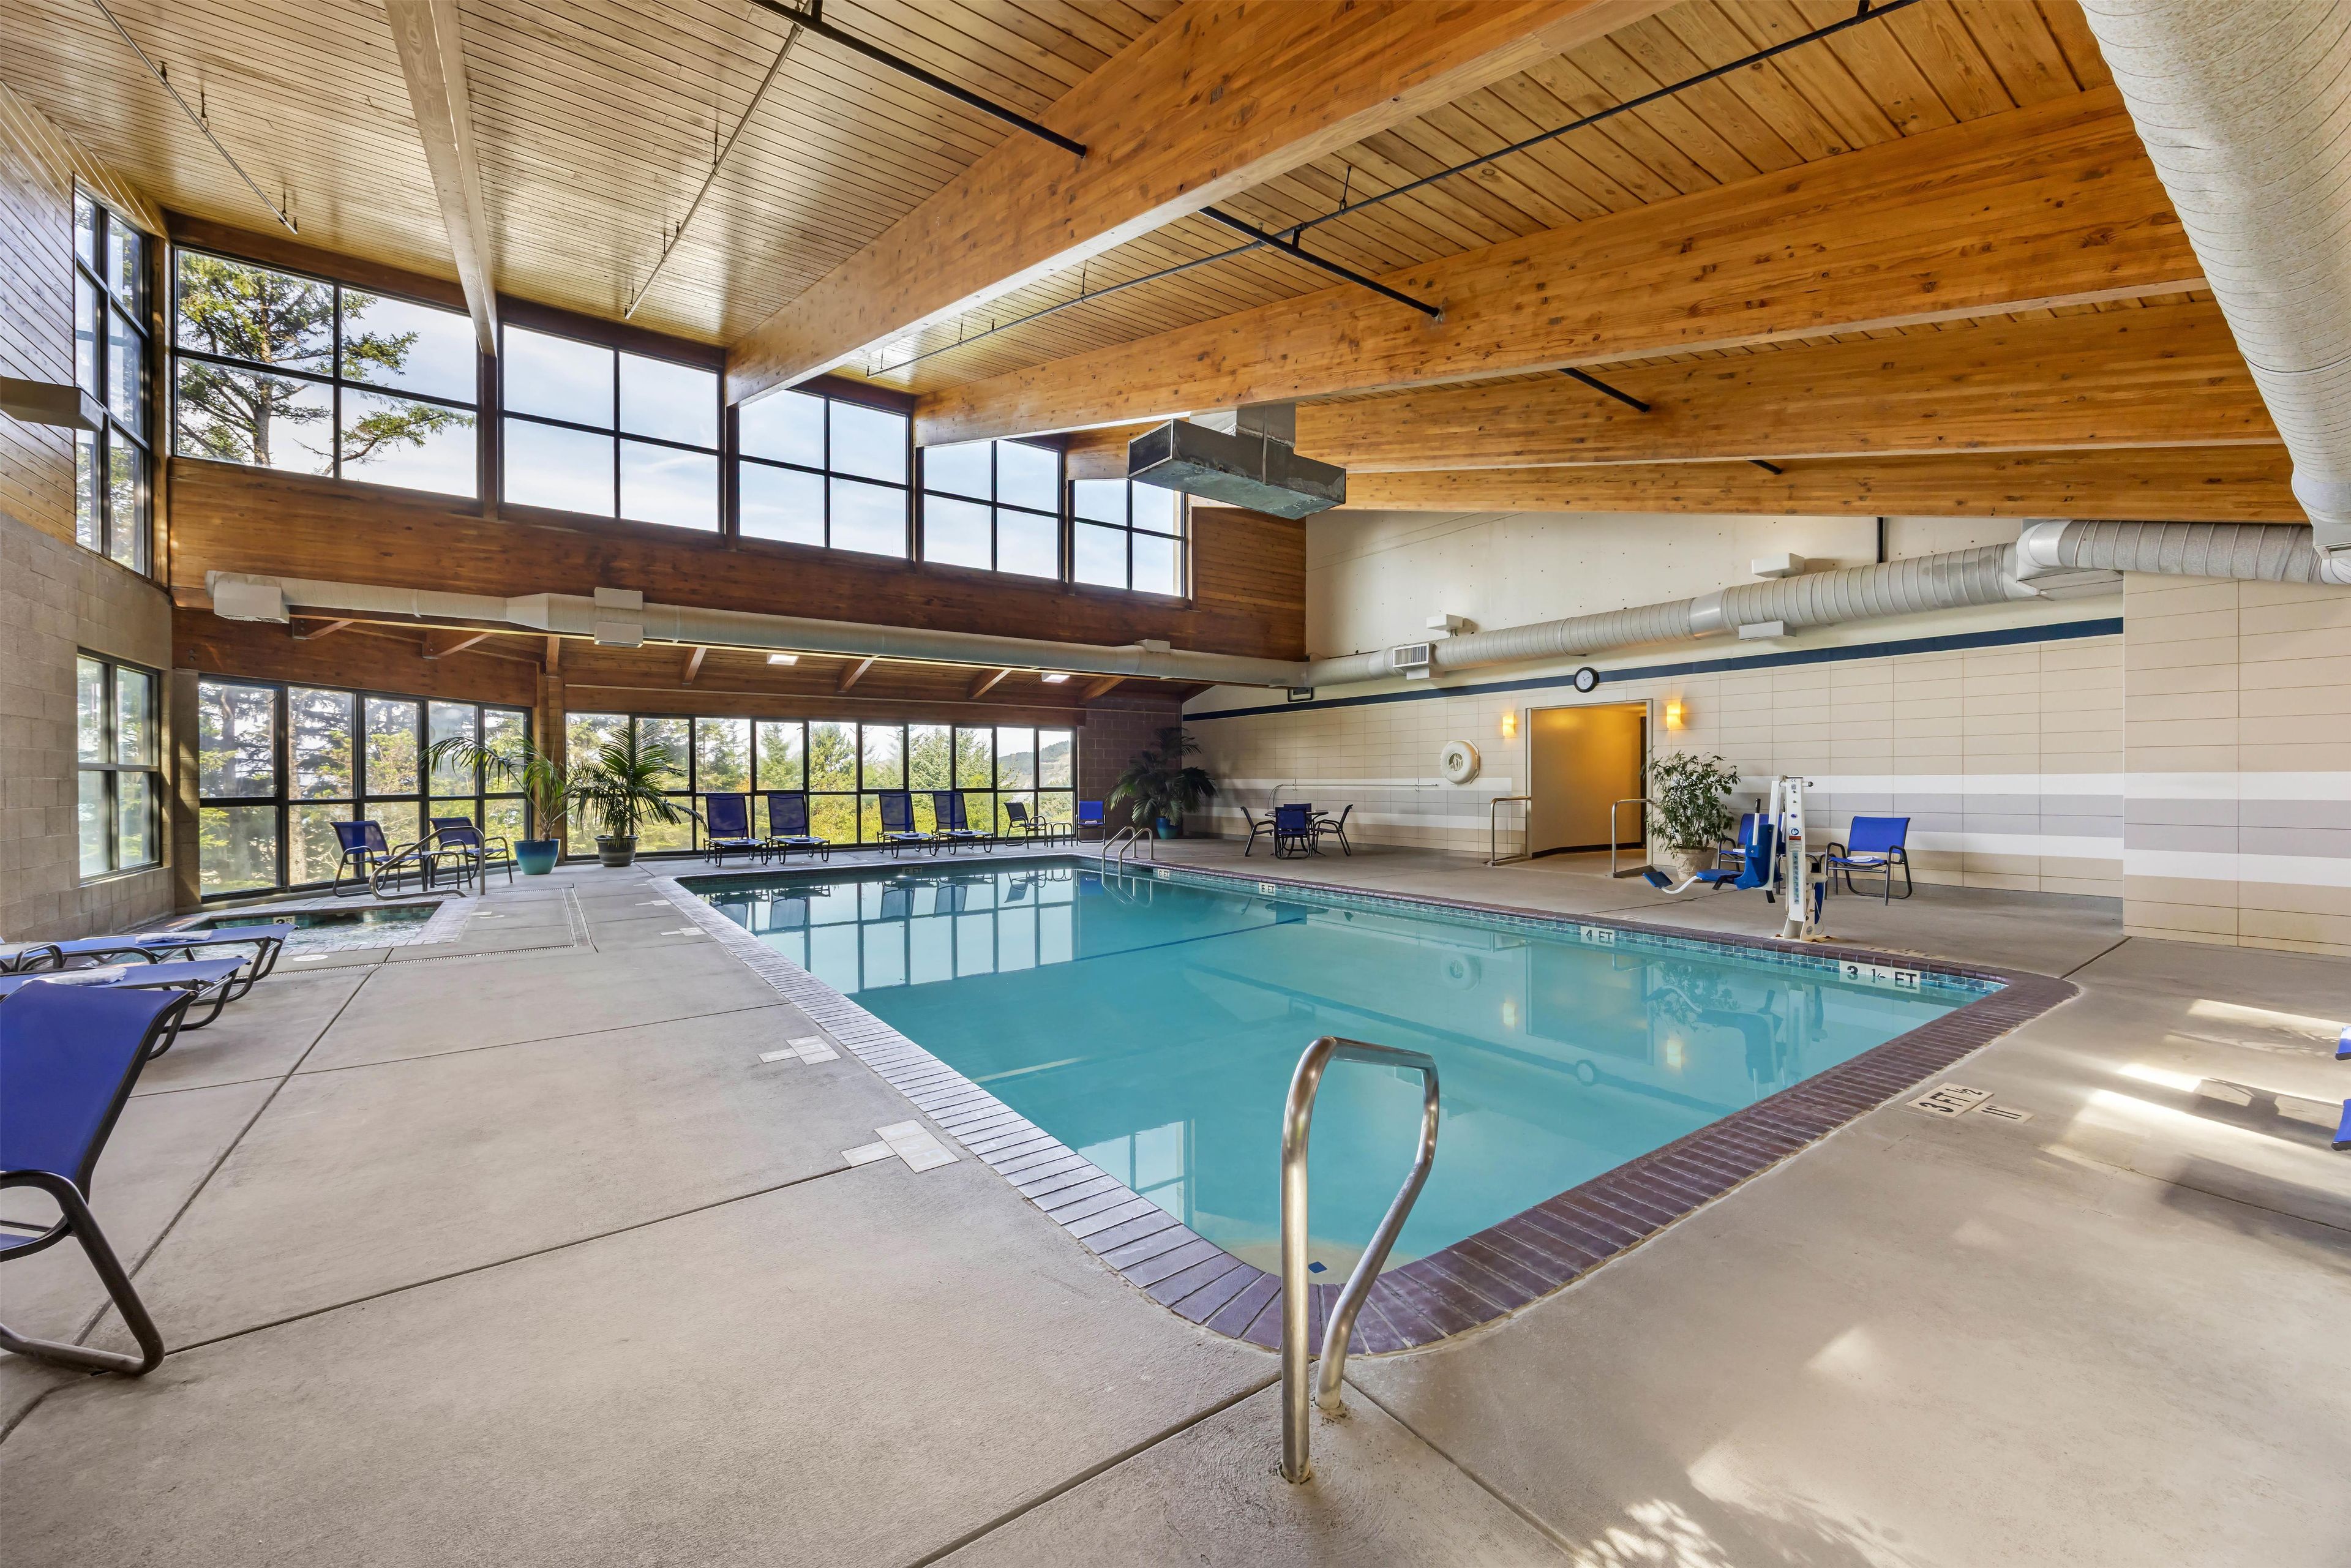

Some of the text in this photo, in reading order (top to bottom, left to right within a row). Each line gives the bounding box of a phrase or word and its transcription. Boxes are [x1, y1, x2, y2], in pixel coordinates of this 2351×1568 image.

[1599, 931, 1613, 942] FT
[1847, 966, 1859, 976] 3
[1894, 971, 1918, 985] FT
[1929, 1092, 1971, 1107] FT
[1918, 1102, 1954, 1113] 3
